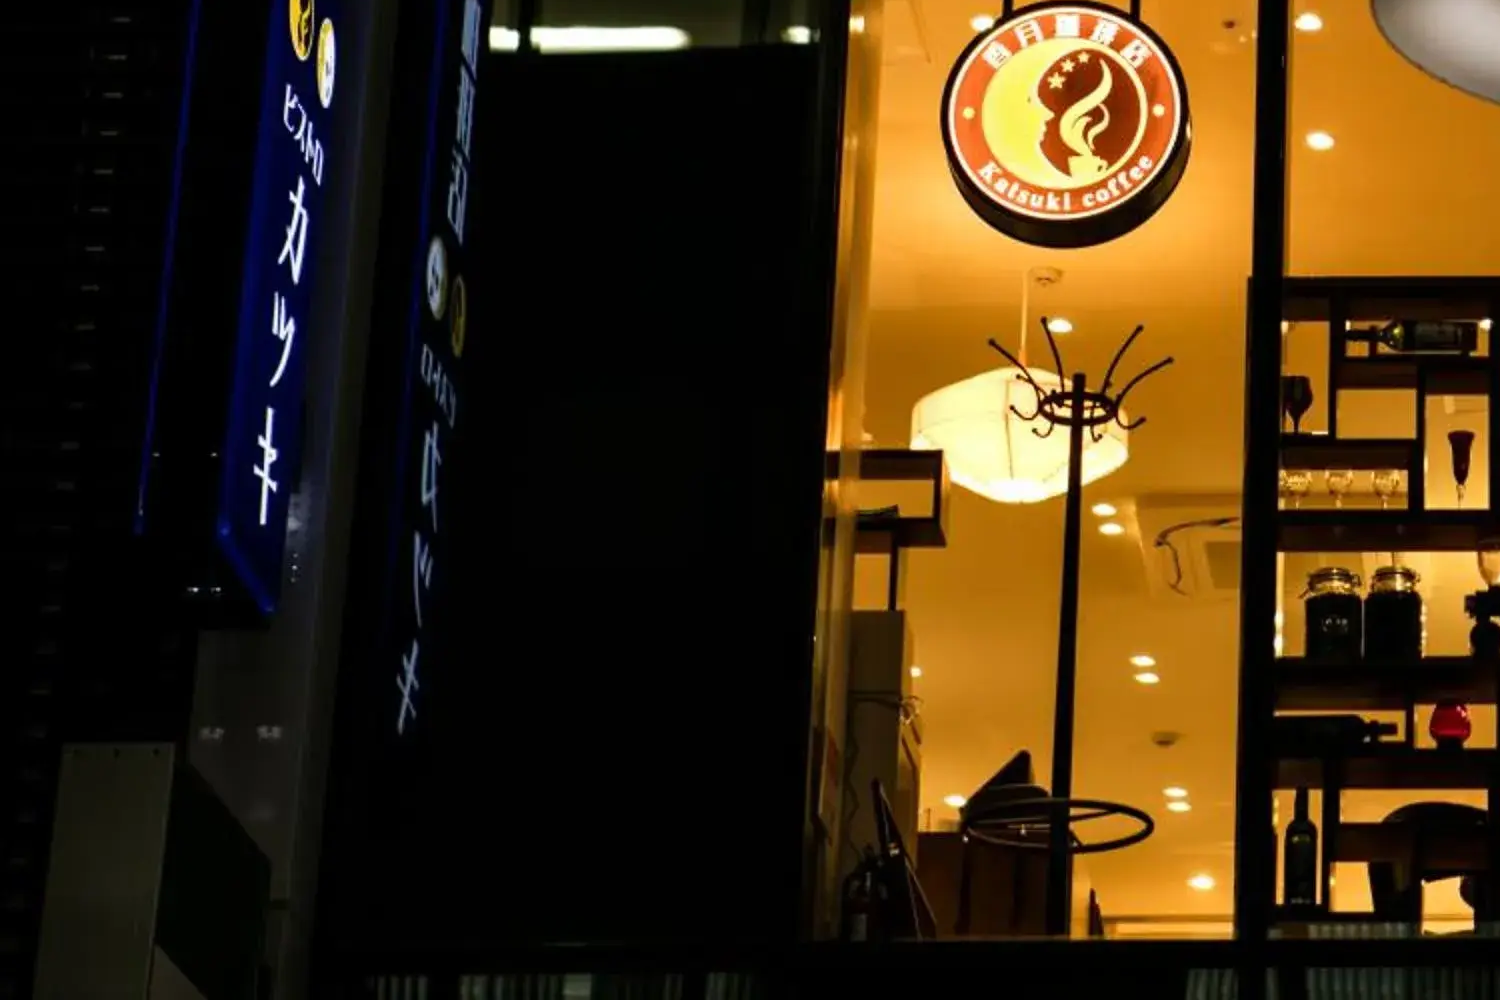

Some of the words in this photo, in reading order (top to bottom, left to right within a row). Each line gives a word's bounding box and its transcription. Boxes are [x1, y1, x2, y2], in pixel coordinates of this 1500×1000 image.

[977, 160, 1072, 212] Katsuki
[1081, 155, 1154, 208] coffee
[253, 174, 310, 526] カツキ
